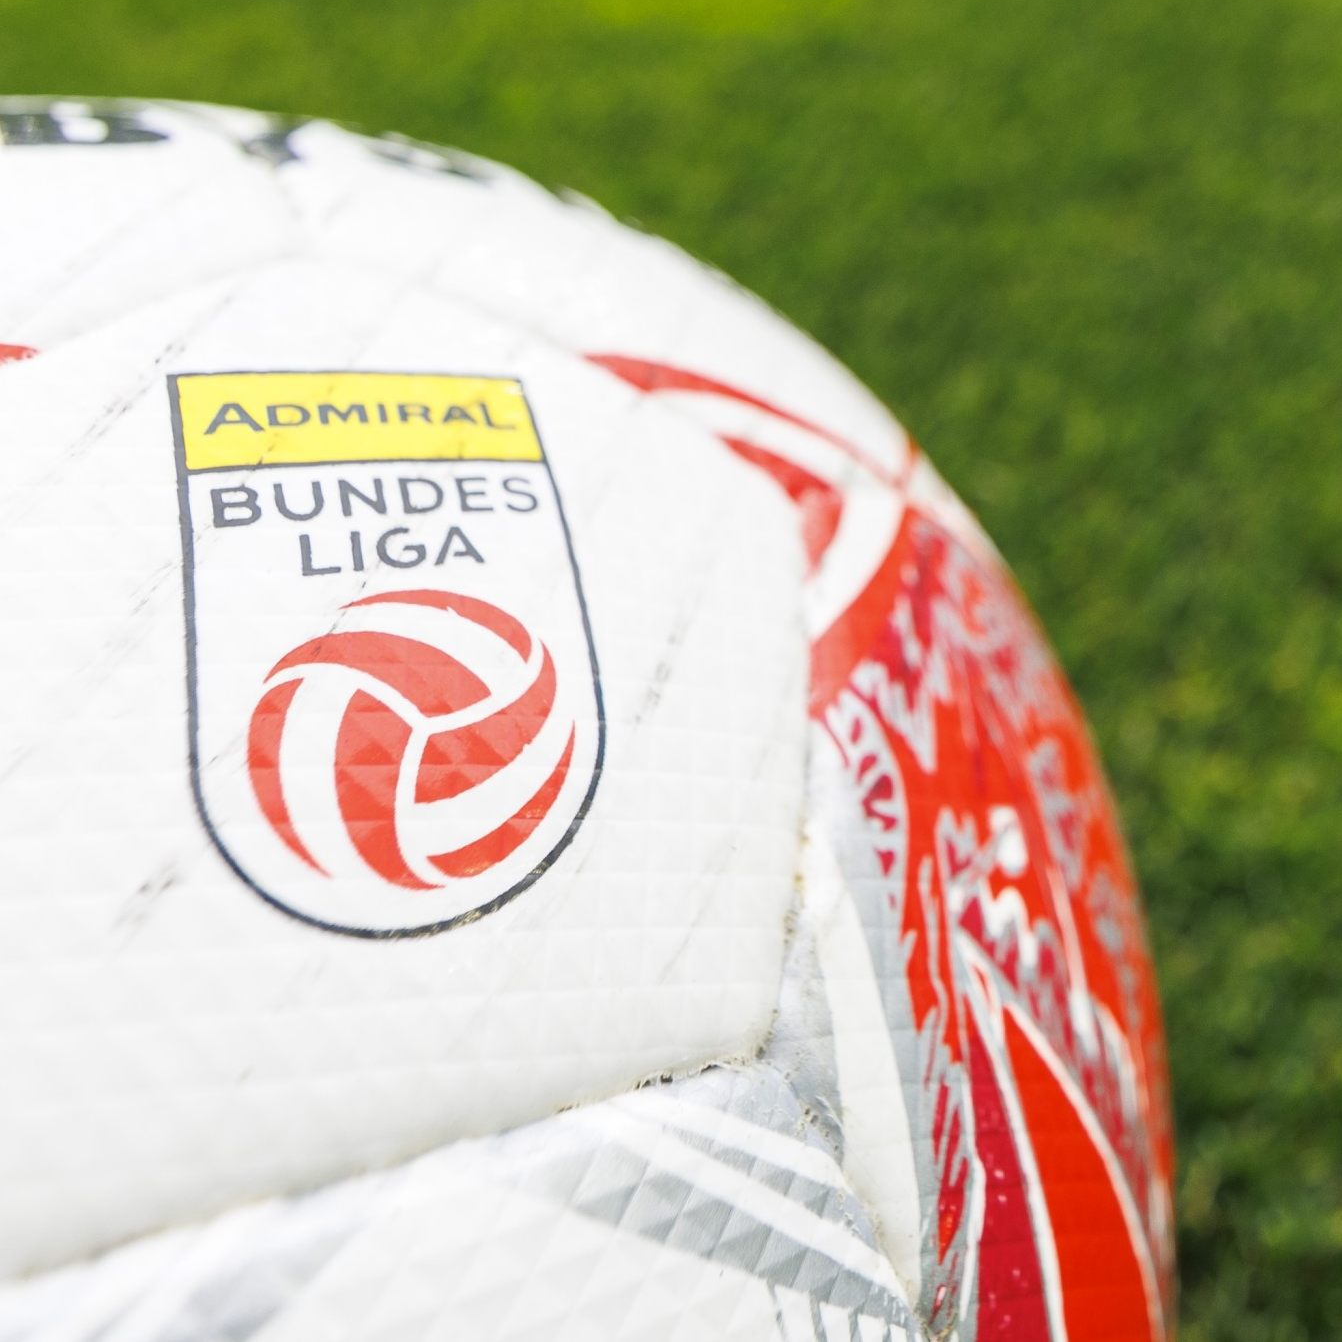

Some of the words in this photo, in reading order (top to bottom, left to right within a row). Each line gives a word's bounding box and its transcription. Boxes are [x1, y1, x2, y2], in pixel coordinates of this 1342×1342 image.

[203, 401, 517, 435] ADMIRAL
[210, 475, 540, 529] BUNDES
[299, 525, 486, 577] LIGA
